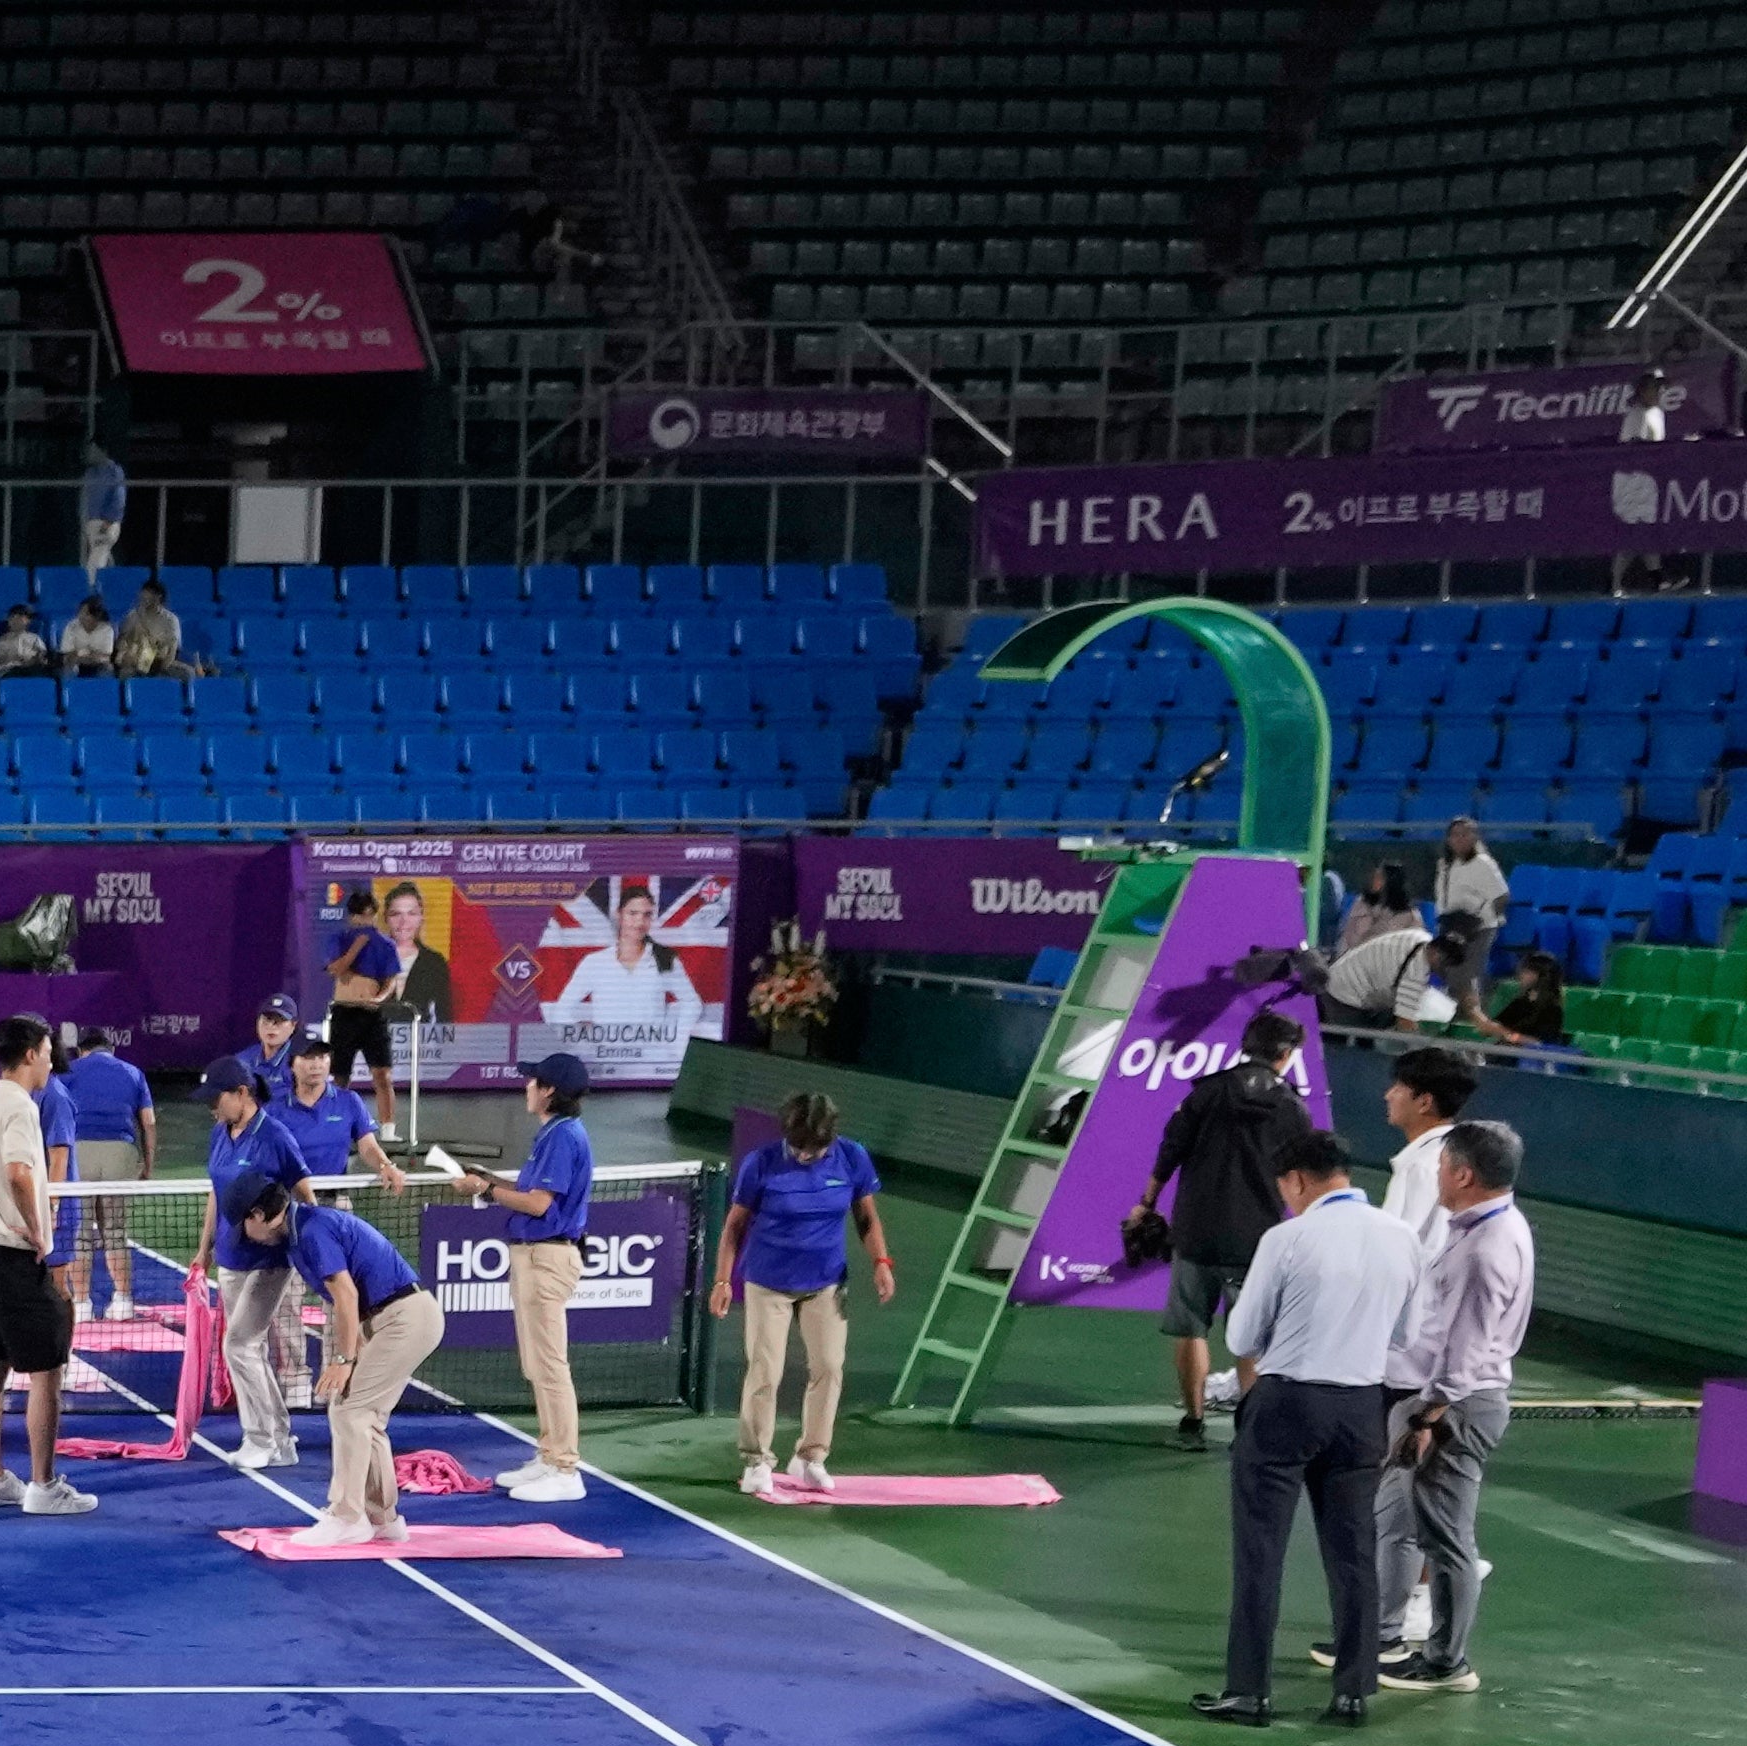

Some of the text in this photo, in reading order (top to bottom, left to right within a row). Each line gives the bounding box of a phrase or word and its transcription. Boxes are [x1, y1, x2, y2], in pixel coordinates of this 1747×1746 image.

[183, 258, 343, 322] 2%
[1493, 384, 1688, 422] Tecnifie
[709, 410, 886, 439] 문화체육관광부
[1663, 477, 1747, 525] Mo
[1028, 492, 1220, 547] HERA
[312, 841, 453, 859] Korea Open 2025
[462, 843, 586, 861] CENTRE COURT
[970, 876, 1101, 915] Wilson
[507, 962, 530, 978] VS
[562, 1024, 678, 1044] RADUCANU
[596, 1045, 642, 1059] Emma
[599, 1287, 612, 1299] of
[615, 1287, 644, 1299] Sure
